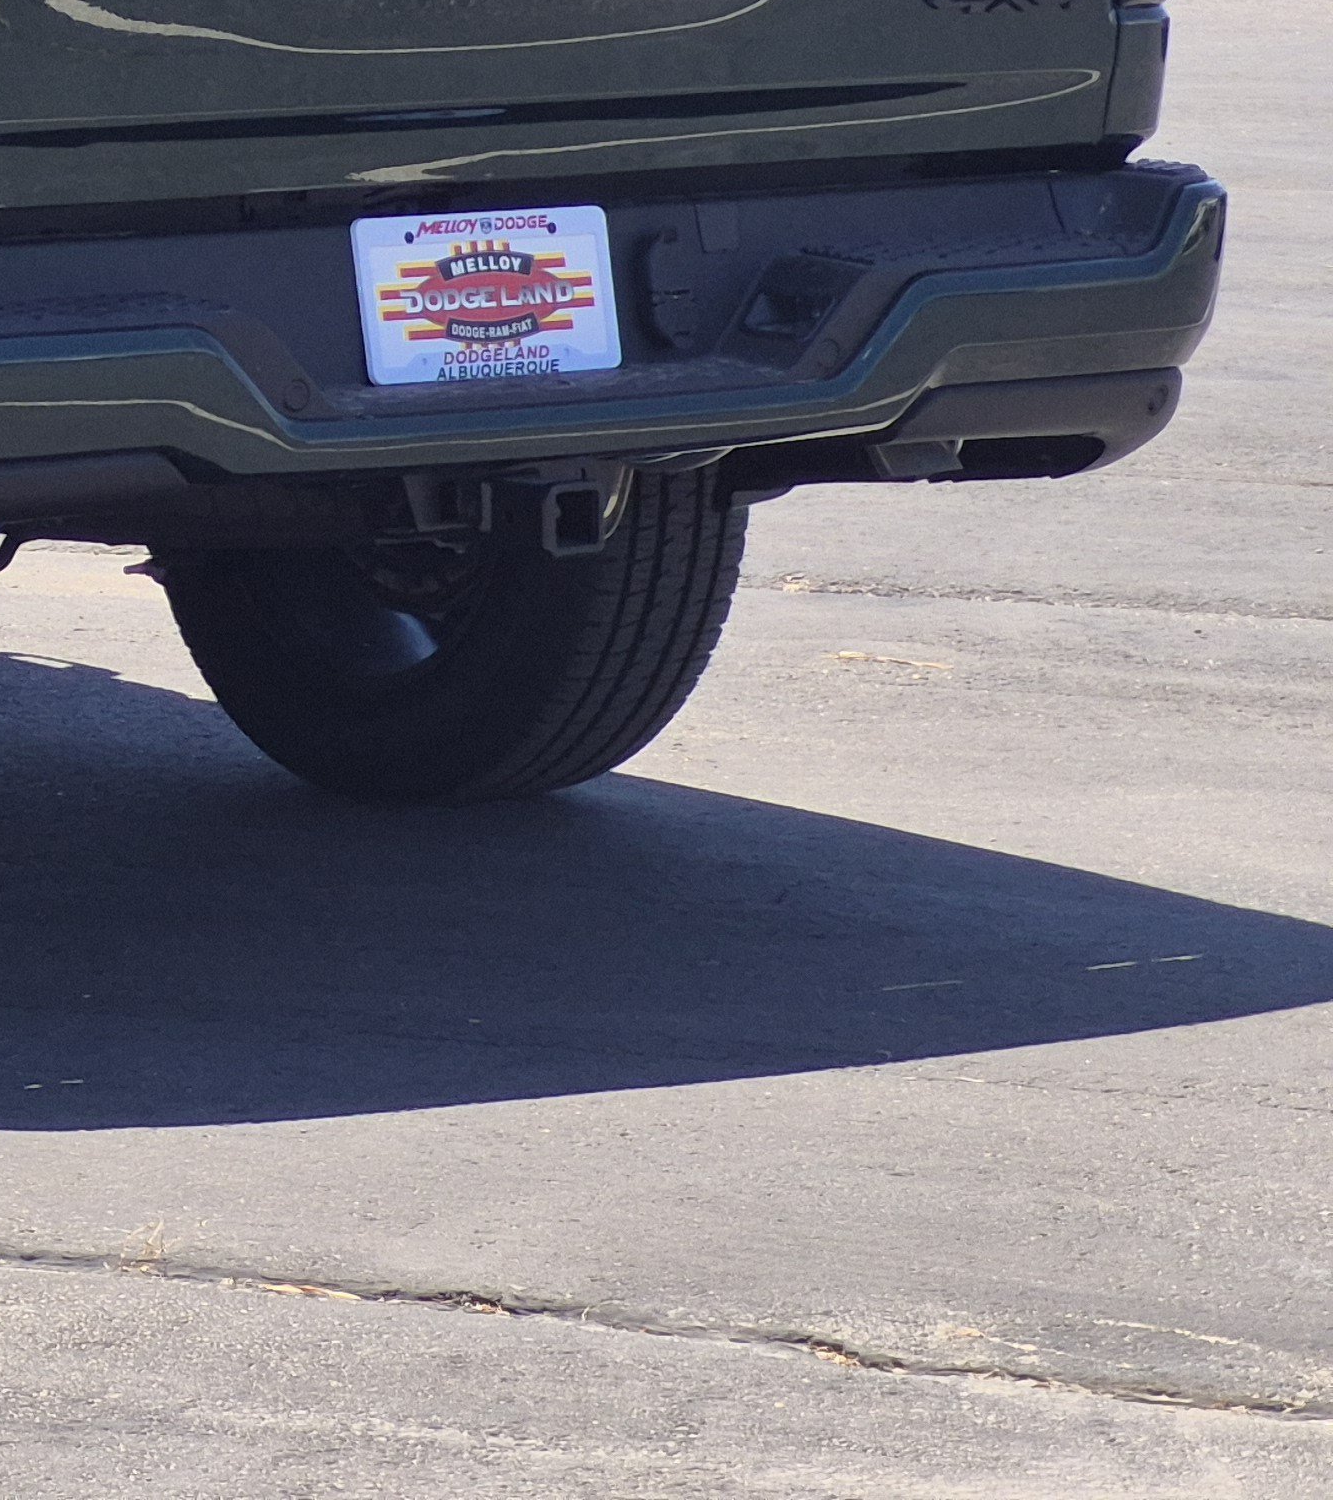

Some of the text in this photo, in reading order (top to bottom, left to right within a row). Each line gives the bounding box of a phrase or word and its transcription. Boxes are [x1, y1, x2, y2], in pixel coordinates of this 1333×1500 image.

[416, 215, 548, 238] MELLOY DODGE
[450, 255, 523, 276] MELLOY
[444, 345, 550, 366] DODGELAND
[437, 358, 560, 381] ALBUQUERQUE
